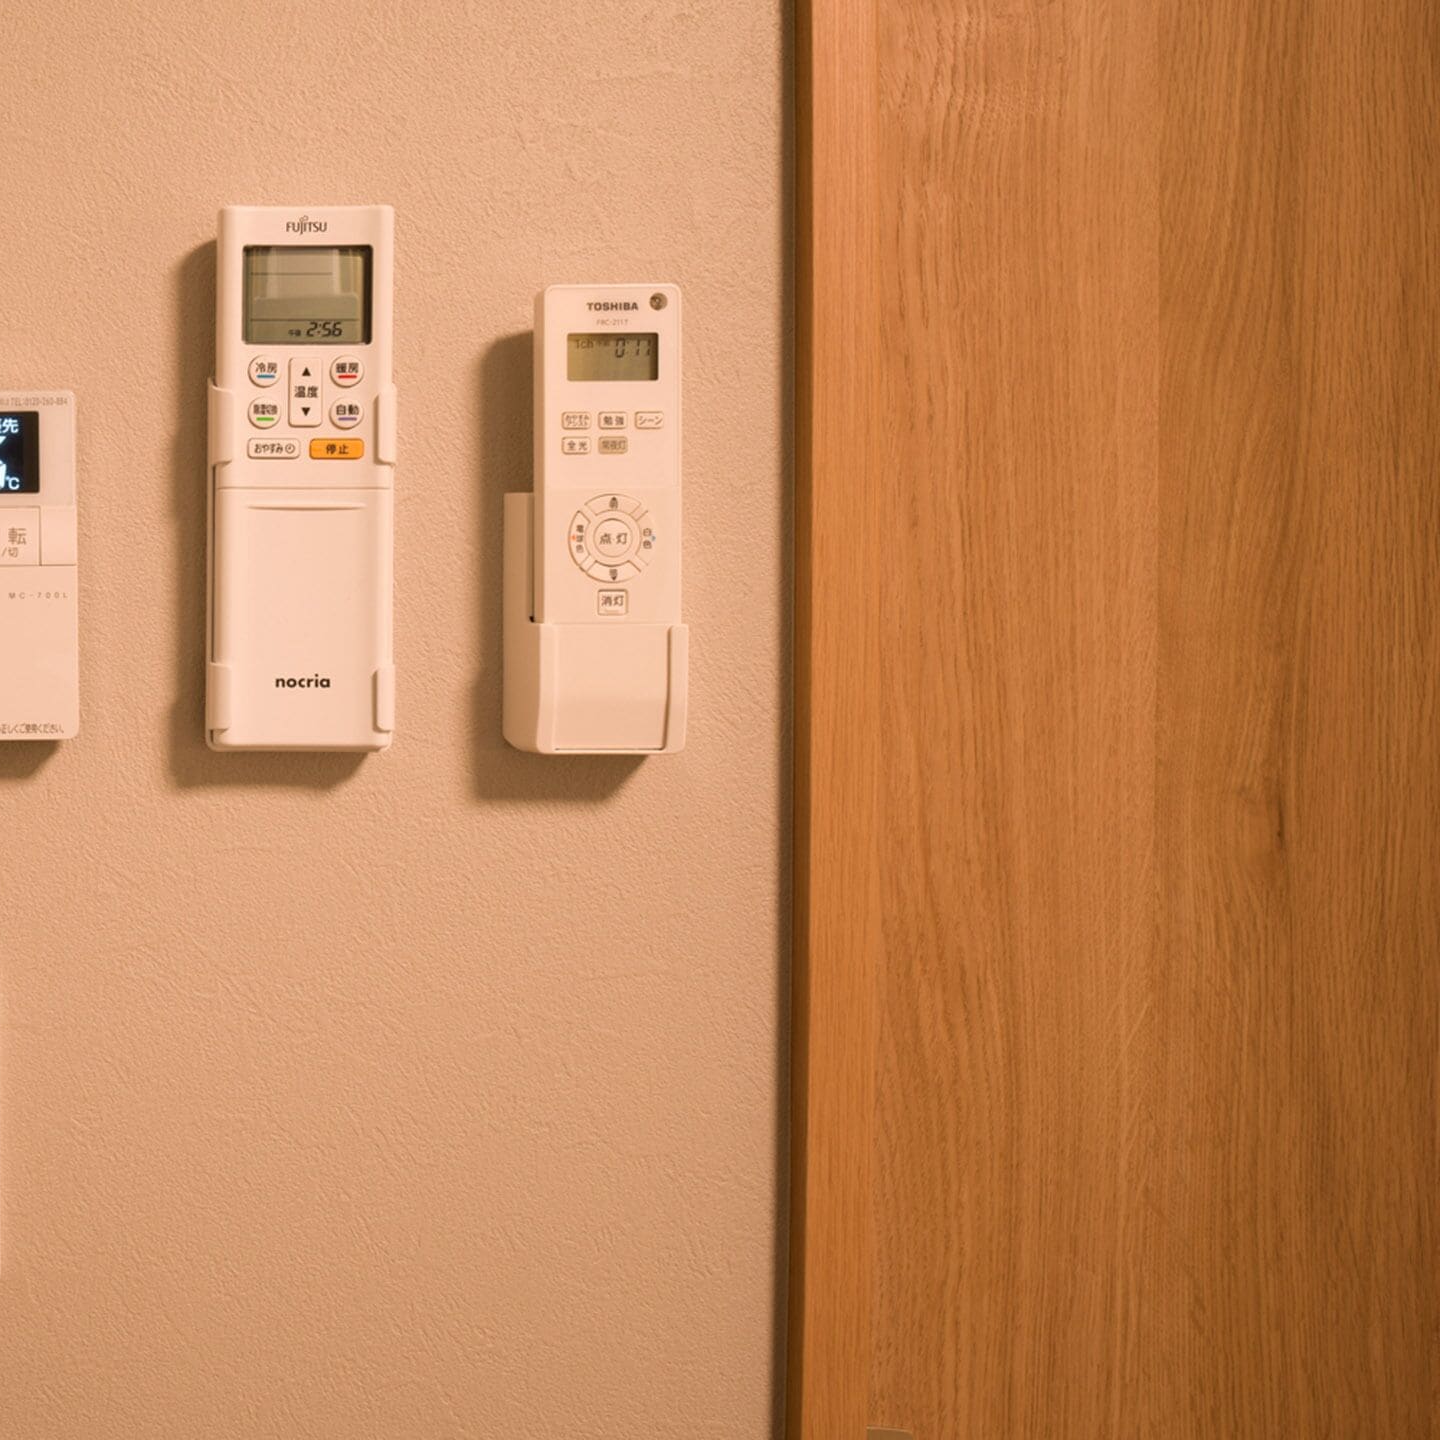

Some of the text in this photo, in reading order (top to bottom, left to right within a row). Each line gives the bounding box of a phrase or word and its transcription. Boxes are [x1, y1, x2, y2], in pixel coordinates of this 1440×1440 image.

[286, 216, 328, 235] FUJITSU
[586, 301, 639, 311] TOSHIBA
[306, 321, 343, 337] 2:56
[255, 362, 278, 374] 冷房
[336, 362, 359, 374] 暖房
[294, 385, 318, 398] 温度
[336, 404, 359, 416] 自動
[639, 415, 663, 426] シーン
[254, 443, 284, 453] おやすみ
[325, 443, 350, 455] 停止
[567, 439, 588, 451] 全光
[599, 532, 628, 545] 点灯
[601, 595, 625, 607] 消灯
[275, 674, 331, 688] nocria
